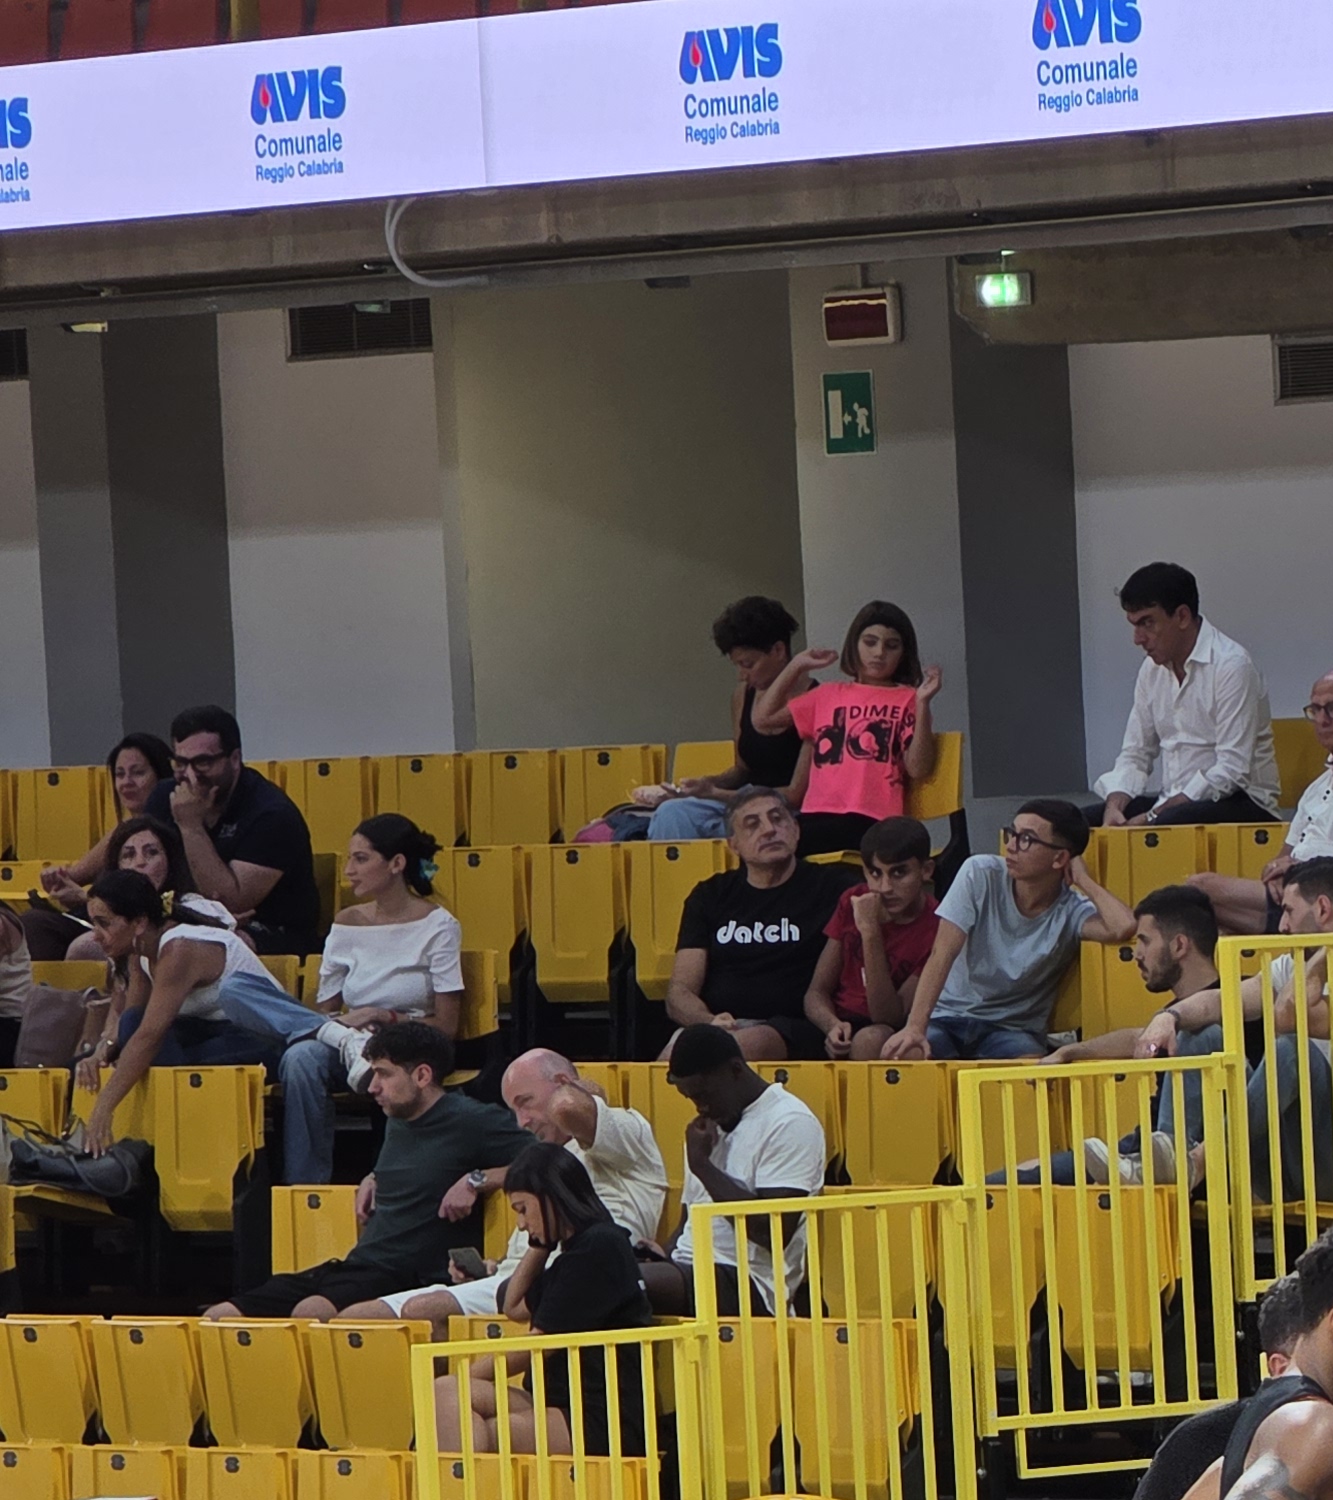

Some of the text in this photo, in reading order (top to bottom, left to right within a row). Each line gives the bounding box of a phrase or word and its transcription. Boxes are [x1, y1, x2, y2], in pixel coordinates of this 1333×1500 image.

[1032, 0, 1143, 50] AVIS
[679, 22, 783, 85] AVIS
[1036, 51, 1138, 86] Comunale
[251, 66, 346, 125] AVIS
[684, 87, 780, 119] Comunale
[1037, 84, 1139, 112] Reggio Calabria
[255, 128, 343, 158] Comunale
[685, 117, 780, 145] Reggio Calabria
[256, 157, 344, 184] Reggio Calabria
[717, 918, 800, 944] datch
